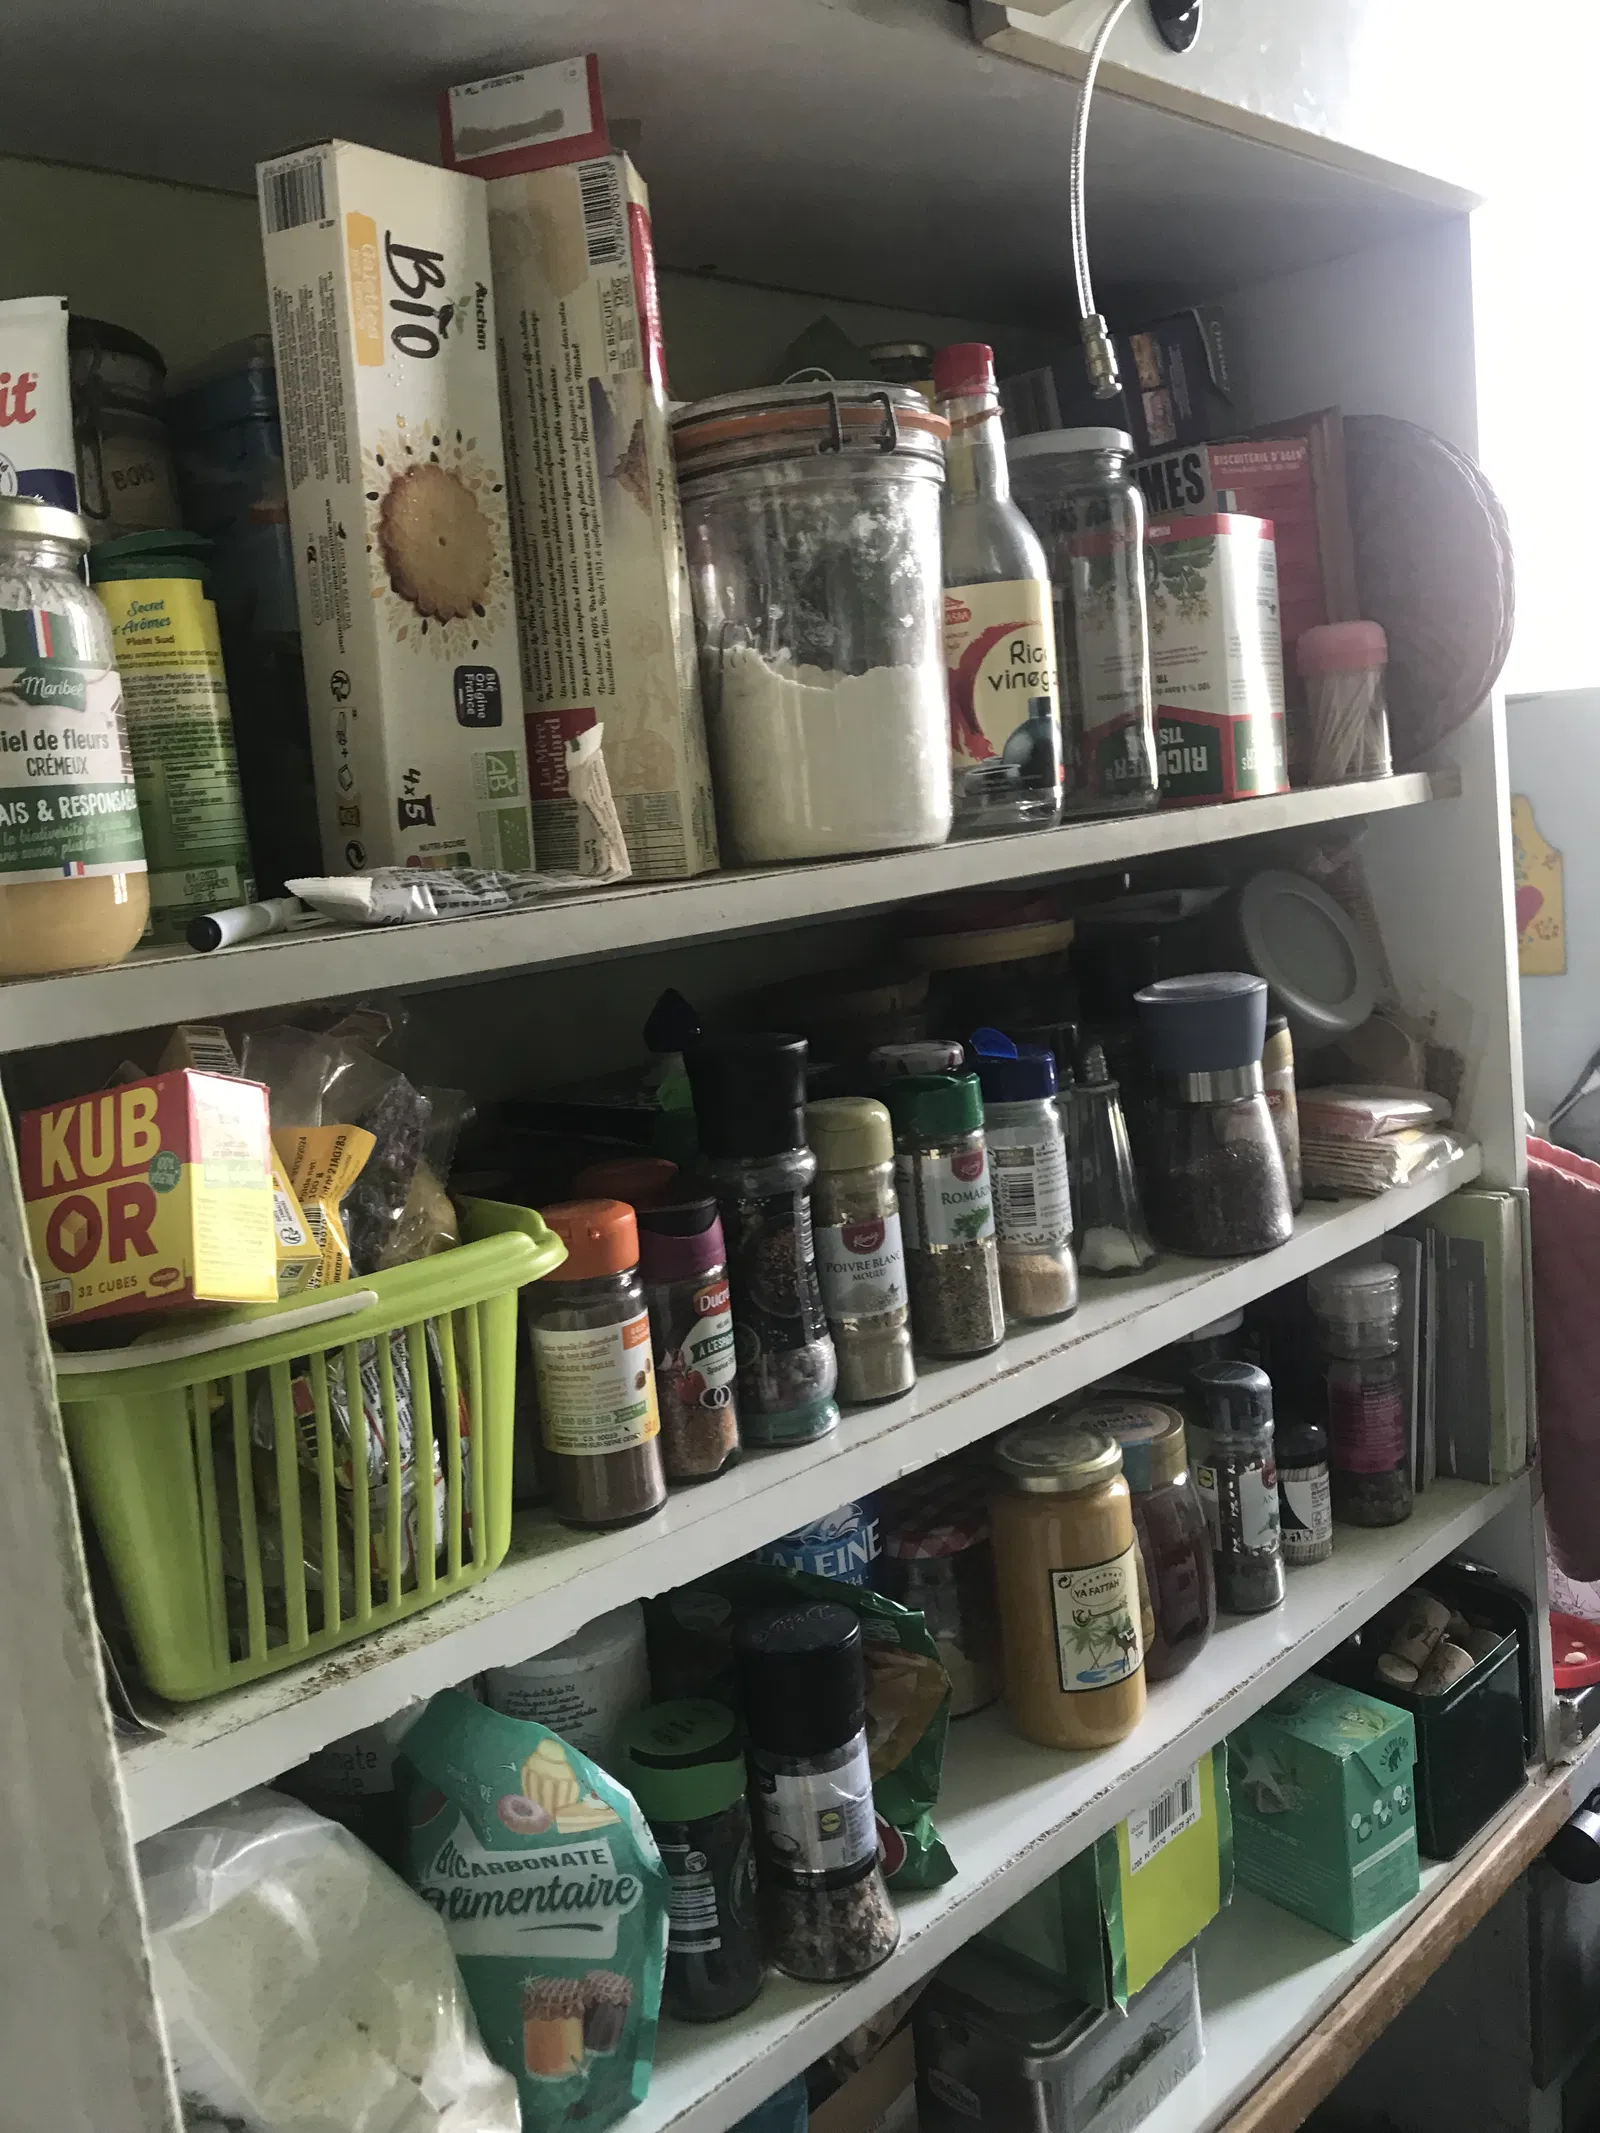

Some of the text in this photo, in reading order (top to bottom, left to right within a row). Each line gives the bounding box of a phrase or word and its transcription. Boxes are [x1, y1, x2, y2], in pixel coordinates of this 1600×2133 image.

[475, 281, 488, 350] Auchan
[603, 291, 615, 346] BISCUITS
[571, 343, 583, 380] Michel
[576, 386, 586, 410] Saint
[578, 416, 590, 444] Mont
[544, 541, 556, 570] depuis
[556, 563, 567, 597] biscuits
[573, 598, 585, 632] simples
[155, 634, 175, 645] Sud
[577, 636, 590, 675] produits
[593, 642, 604, 674] biscuits
[464, 673, 476, 715] France
[473, 673, 487, 719] Origine
[485, 673, 498, 693] Blé
[33, 730, 59, 751] de
[63, 729, 109, 750] fleurs
[535, 724, 548, 762] Mère
[545, 718, 568, 792] Poulard
[26, 755, 89, 778] CRÉMEUX
[486, 754, 510, 793] AB
[37, 799, 54, 822] &
[41, 1086, 161, 1188] KUB
[46, 1181, 159, 1273] OR
[826, 1260, 871, 1274] POIVRE
[852, 1269, 886, 1282] MOULU
[78, 1285, 93, 1299] 32
[98, 1275, 138, 1294] CUBES
[1074, 1578, 1120, 1599] YA FATTAH
[435, 1838, 607, 1880] BICARBONATE
